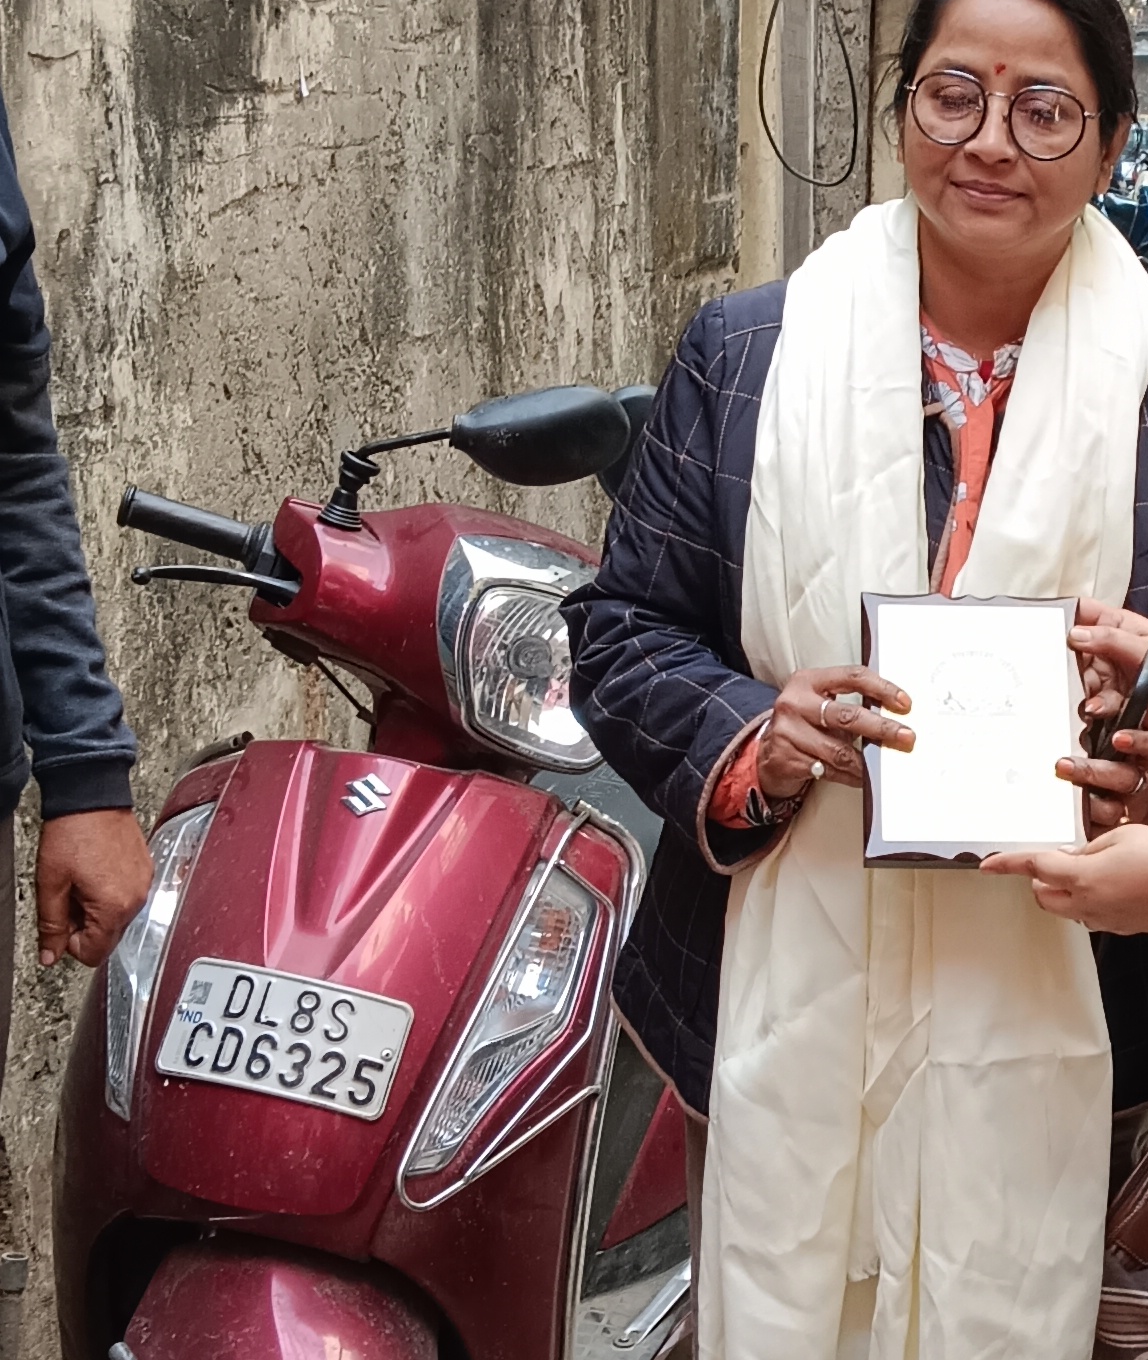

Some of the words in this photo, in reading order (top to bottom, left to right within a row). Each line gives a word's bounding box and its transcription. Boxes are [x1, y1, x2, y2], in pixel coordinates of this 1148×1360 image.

[180, 1011, 203, 1024] IND
[222, 974, 356, 1042] DL8S
[184, 1022, 384, 1106] CD6325
